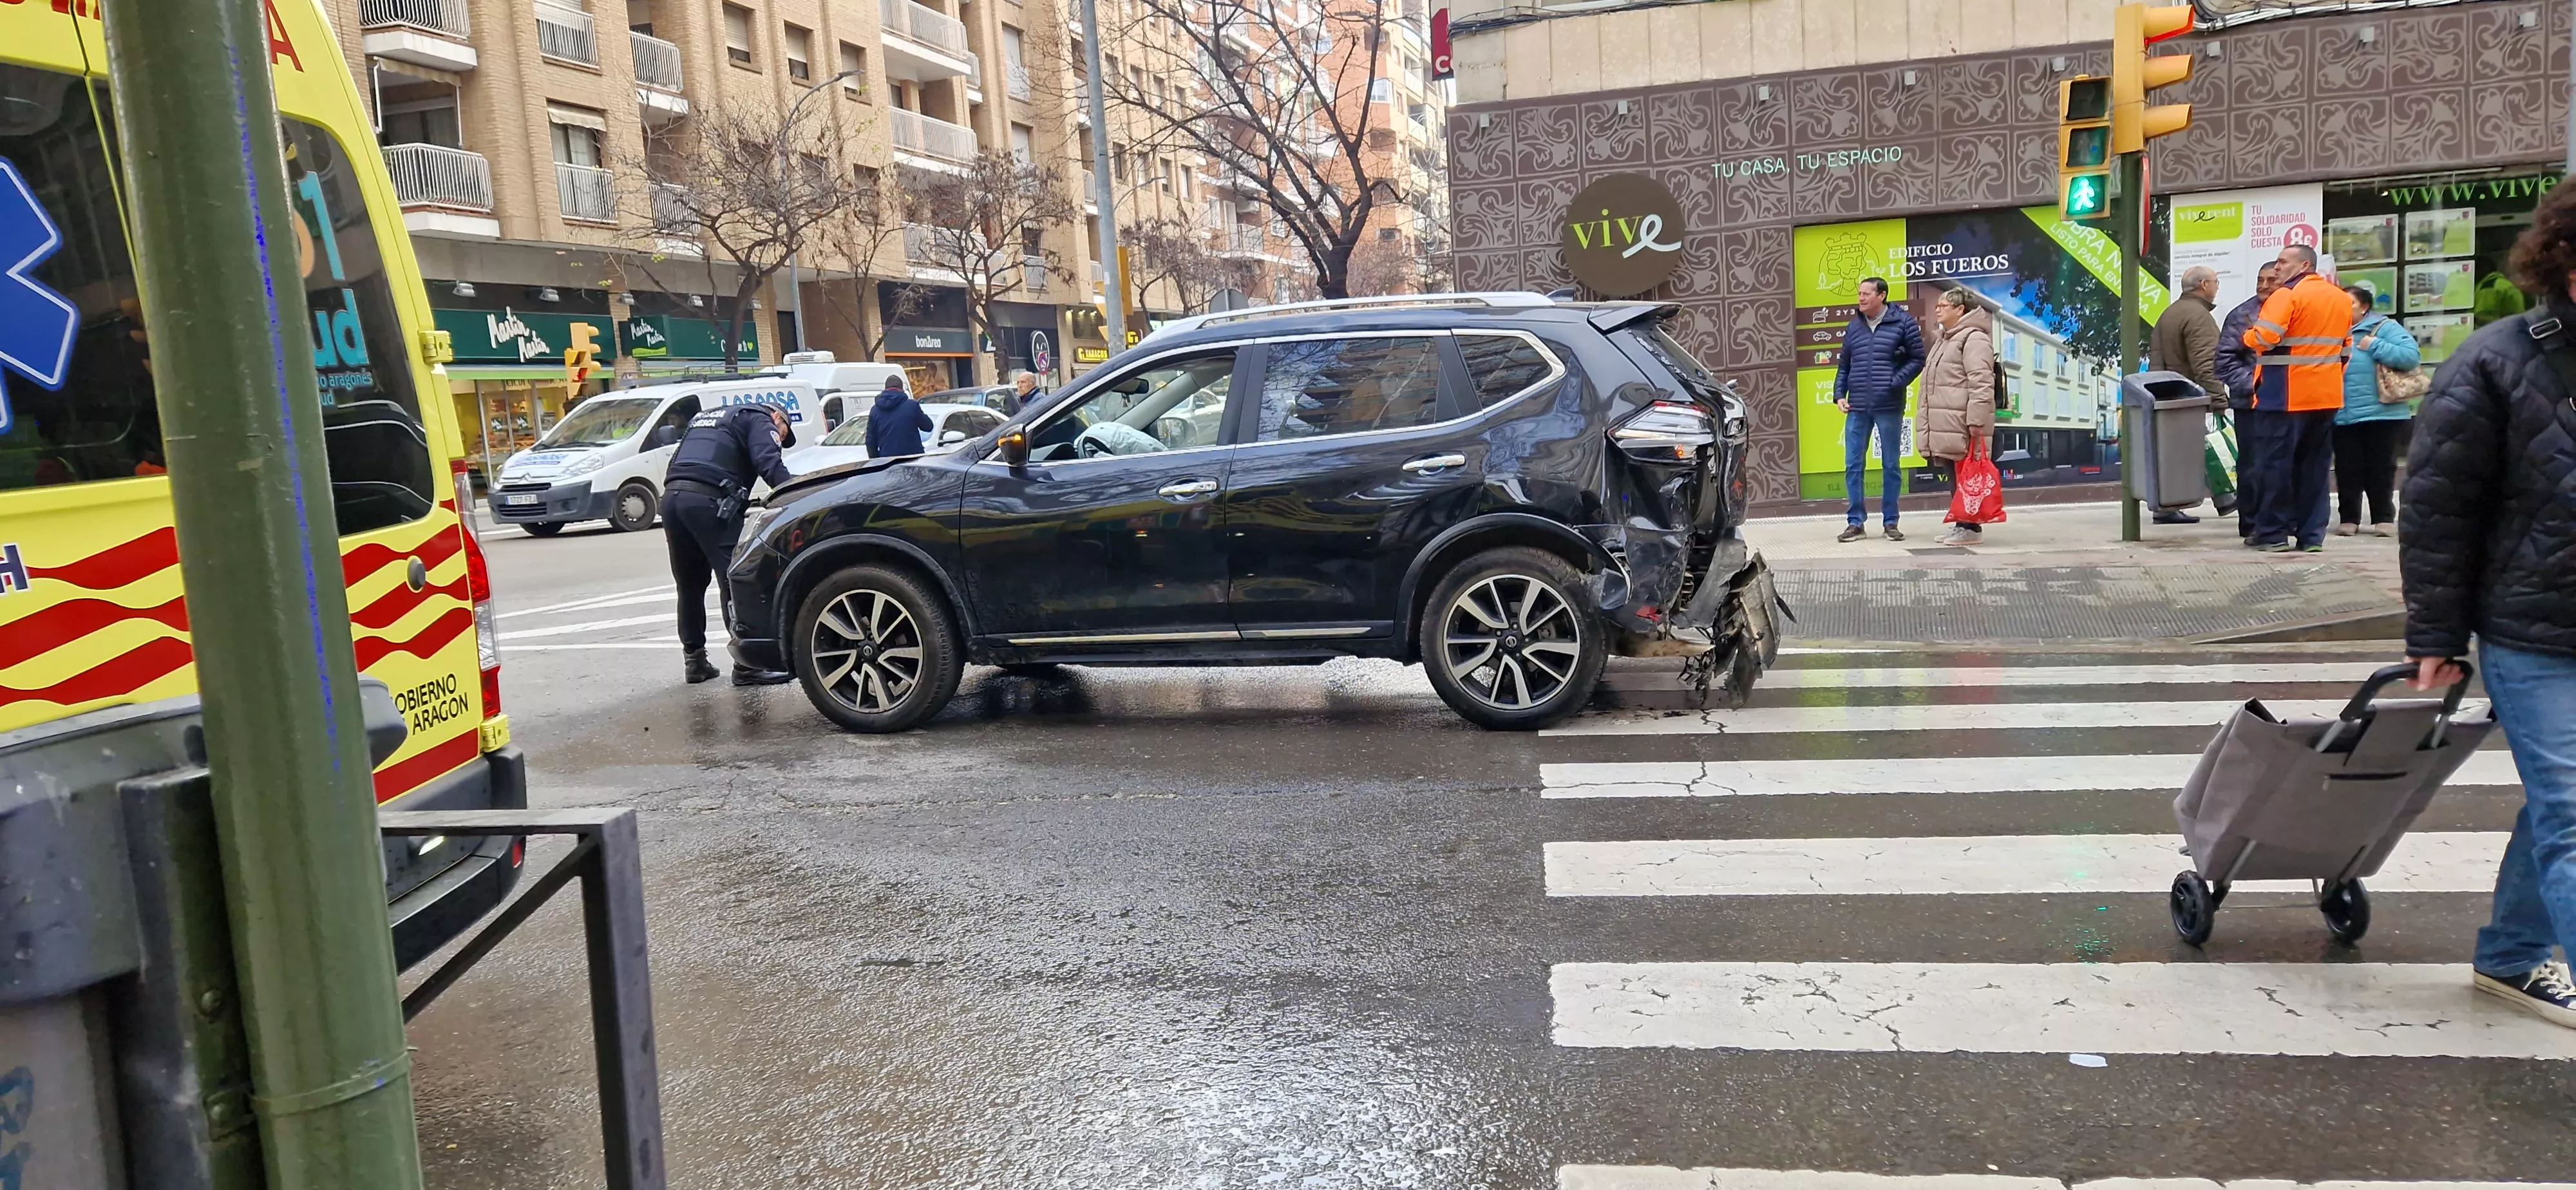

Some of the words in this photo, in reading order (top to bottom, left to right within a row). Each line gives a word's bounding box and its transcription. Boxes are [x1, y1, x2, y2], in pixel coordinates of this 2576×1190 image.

[1711, 162, 1734, 178] TU
[1740, 157, 1790, 175] CASA,
[1797, 153, 1819, 170] TU
[1828, 146, 1902, 167] ESPACIO
[2251, 205, 2262, 215] TU
[2251, 212, 2306, 226] SOLIDARIDAD
[1569, 209, 1682, 259] vive
[2251, 227, 2272, 238] SOLO
[2251, 236, 2282, 249] CUESTA
[1889, 243, 1953, 259] EDIFICIO
[2050, 223, 2078, 249] LISTO
[2078, 247, 2104, 273] PARA
[1889, 261, 1926, 278] LOS
[1931, 254, 2009, 275] FUEROS
[314, 288, 369, 367] ud
[392, 673, 456, 715] OBIERNO
[412, 692, 469, 735] ARAGON
